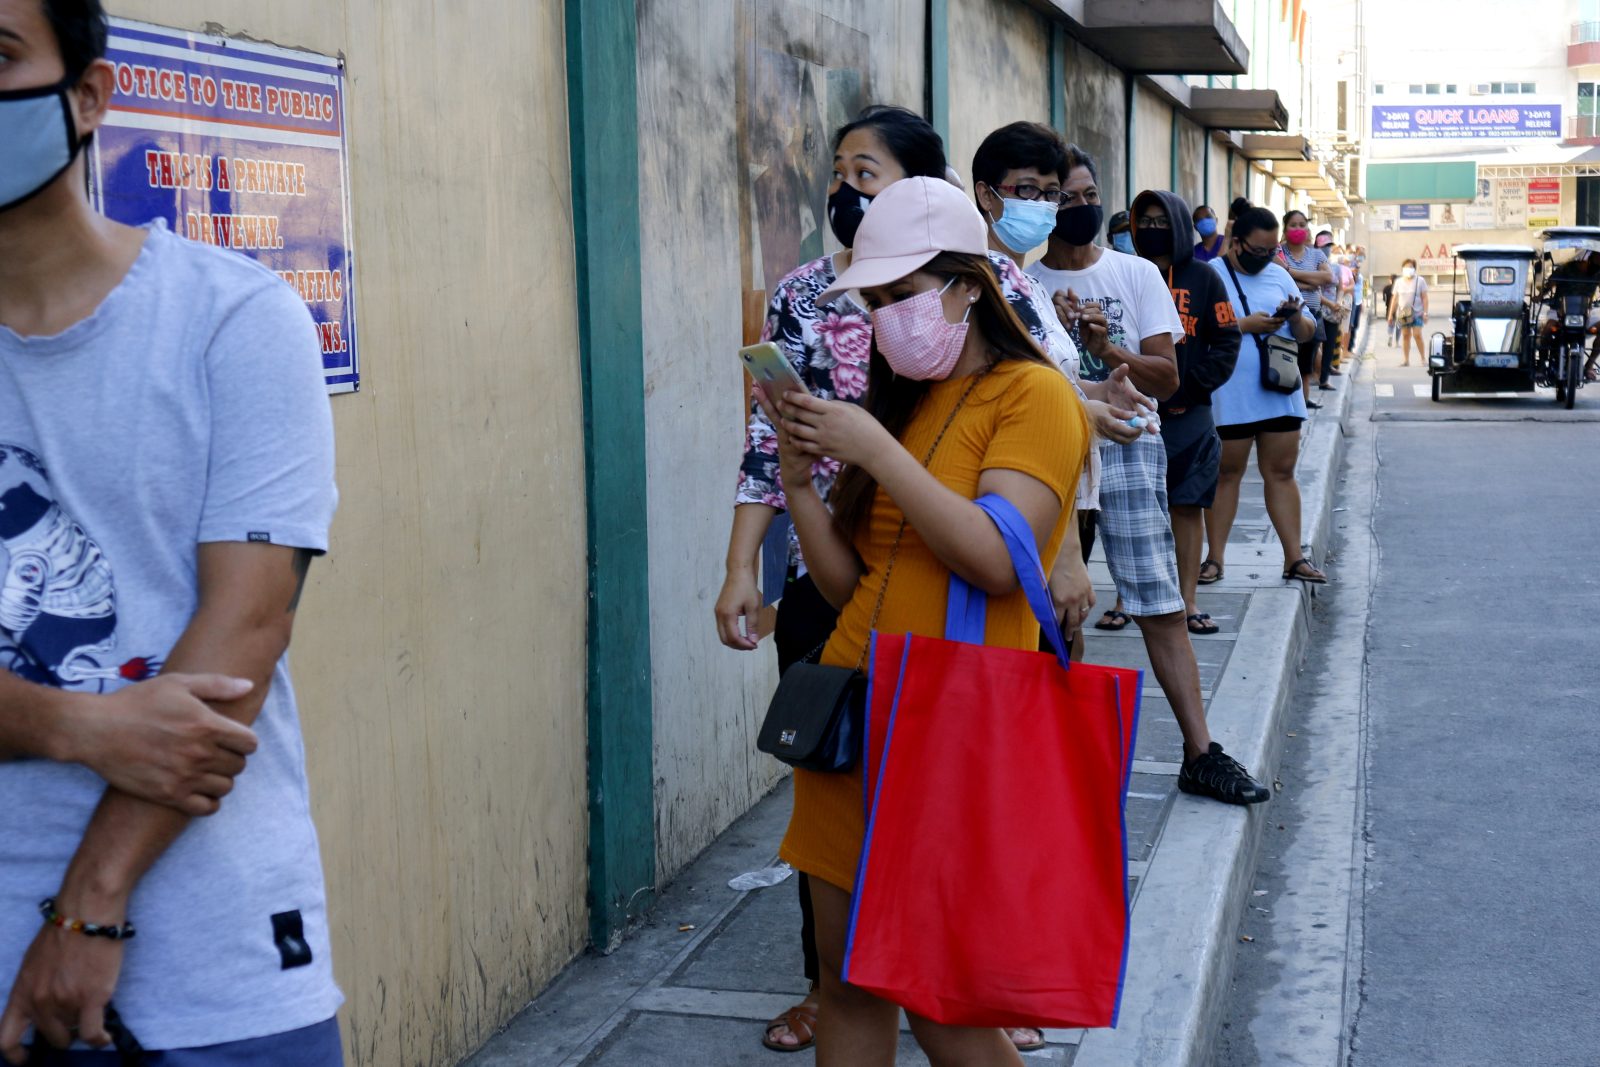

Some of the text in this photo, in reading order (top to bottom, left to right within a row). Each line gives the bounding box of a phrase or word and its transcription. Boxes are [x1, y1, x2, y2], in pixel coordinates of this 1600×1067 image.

[190, 75, 217, 106] TO
[221, 79, 262, 112] THE
[266, 86, 334, 122] PUBLIC
[1415, 109, 1519, 124] QUICK LOANS
[1525, 120, 1552, 128] RELEASE
[146, 150, 306, 196] THIS IS A PRIVATE
[187, 213, 284, 249] DRIVEWAY.
